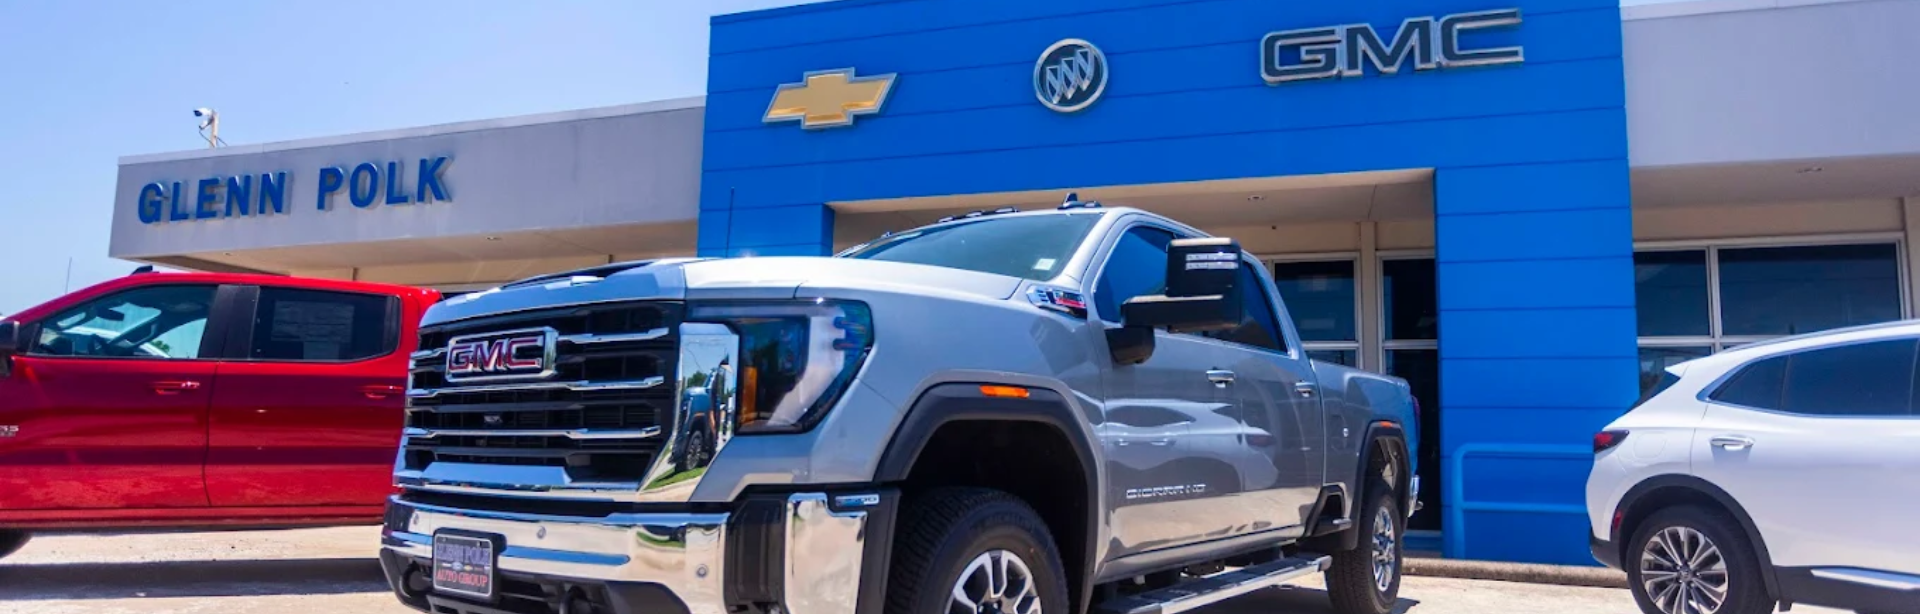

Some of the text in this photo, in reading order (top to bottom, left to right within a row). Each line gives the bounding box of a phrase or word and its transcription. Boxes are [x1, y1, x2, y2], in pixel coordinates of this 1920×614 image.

[1261, 8, 1524, 85] GMC
[138, 156, 453, 225] GLENN POLK
[449, 336, 543, 373] GMC
